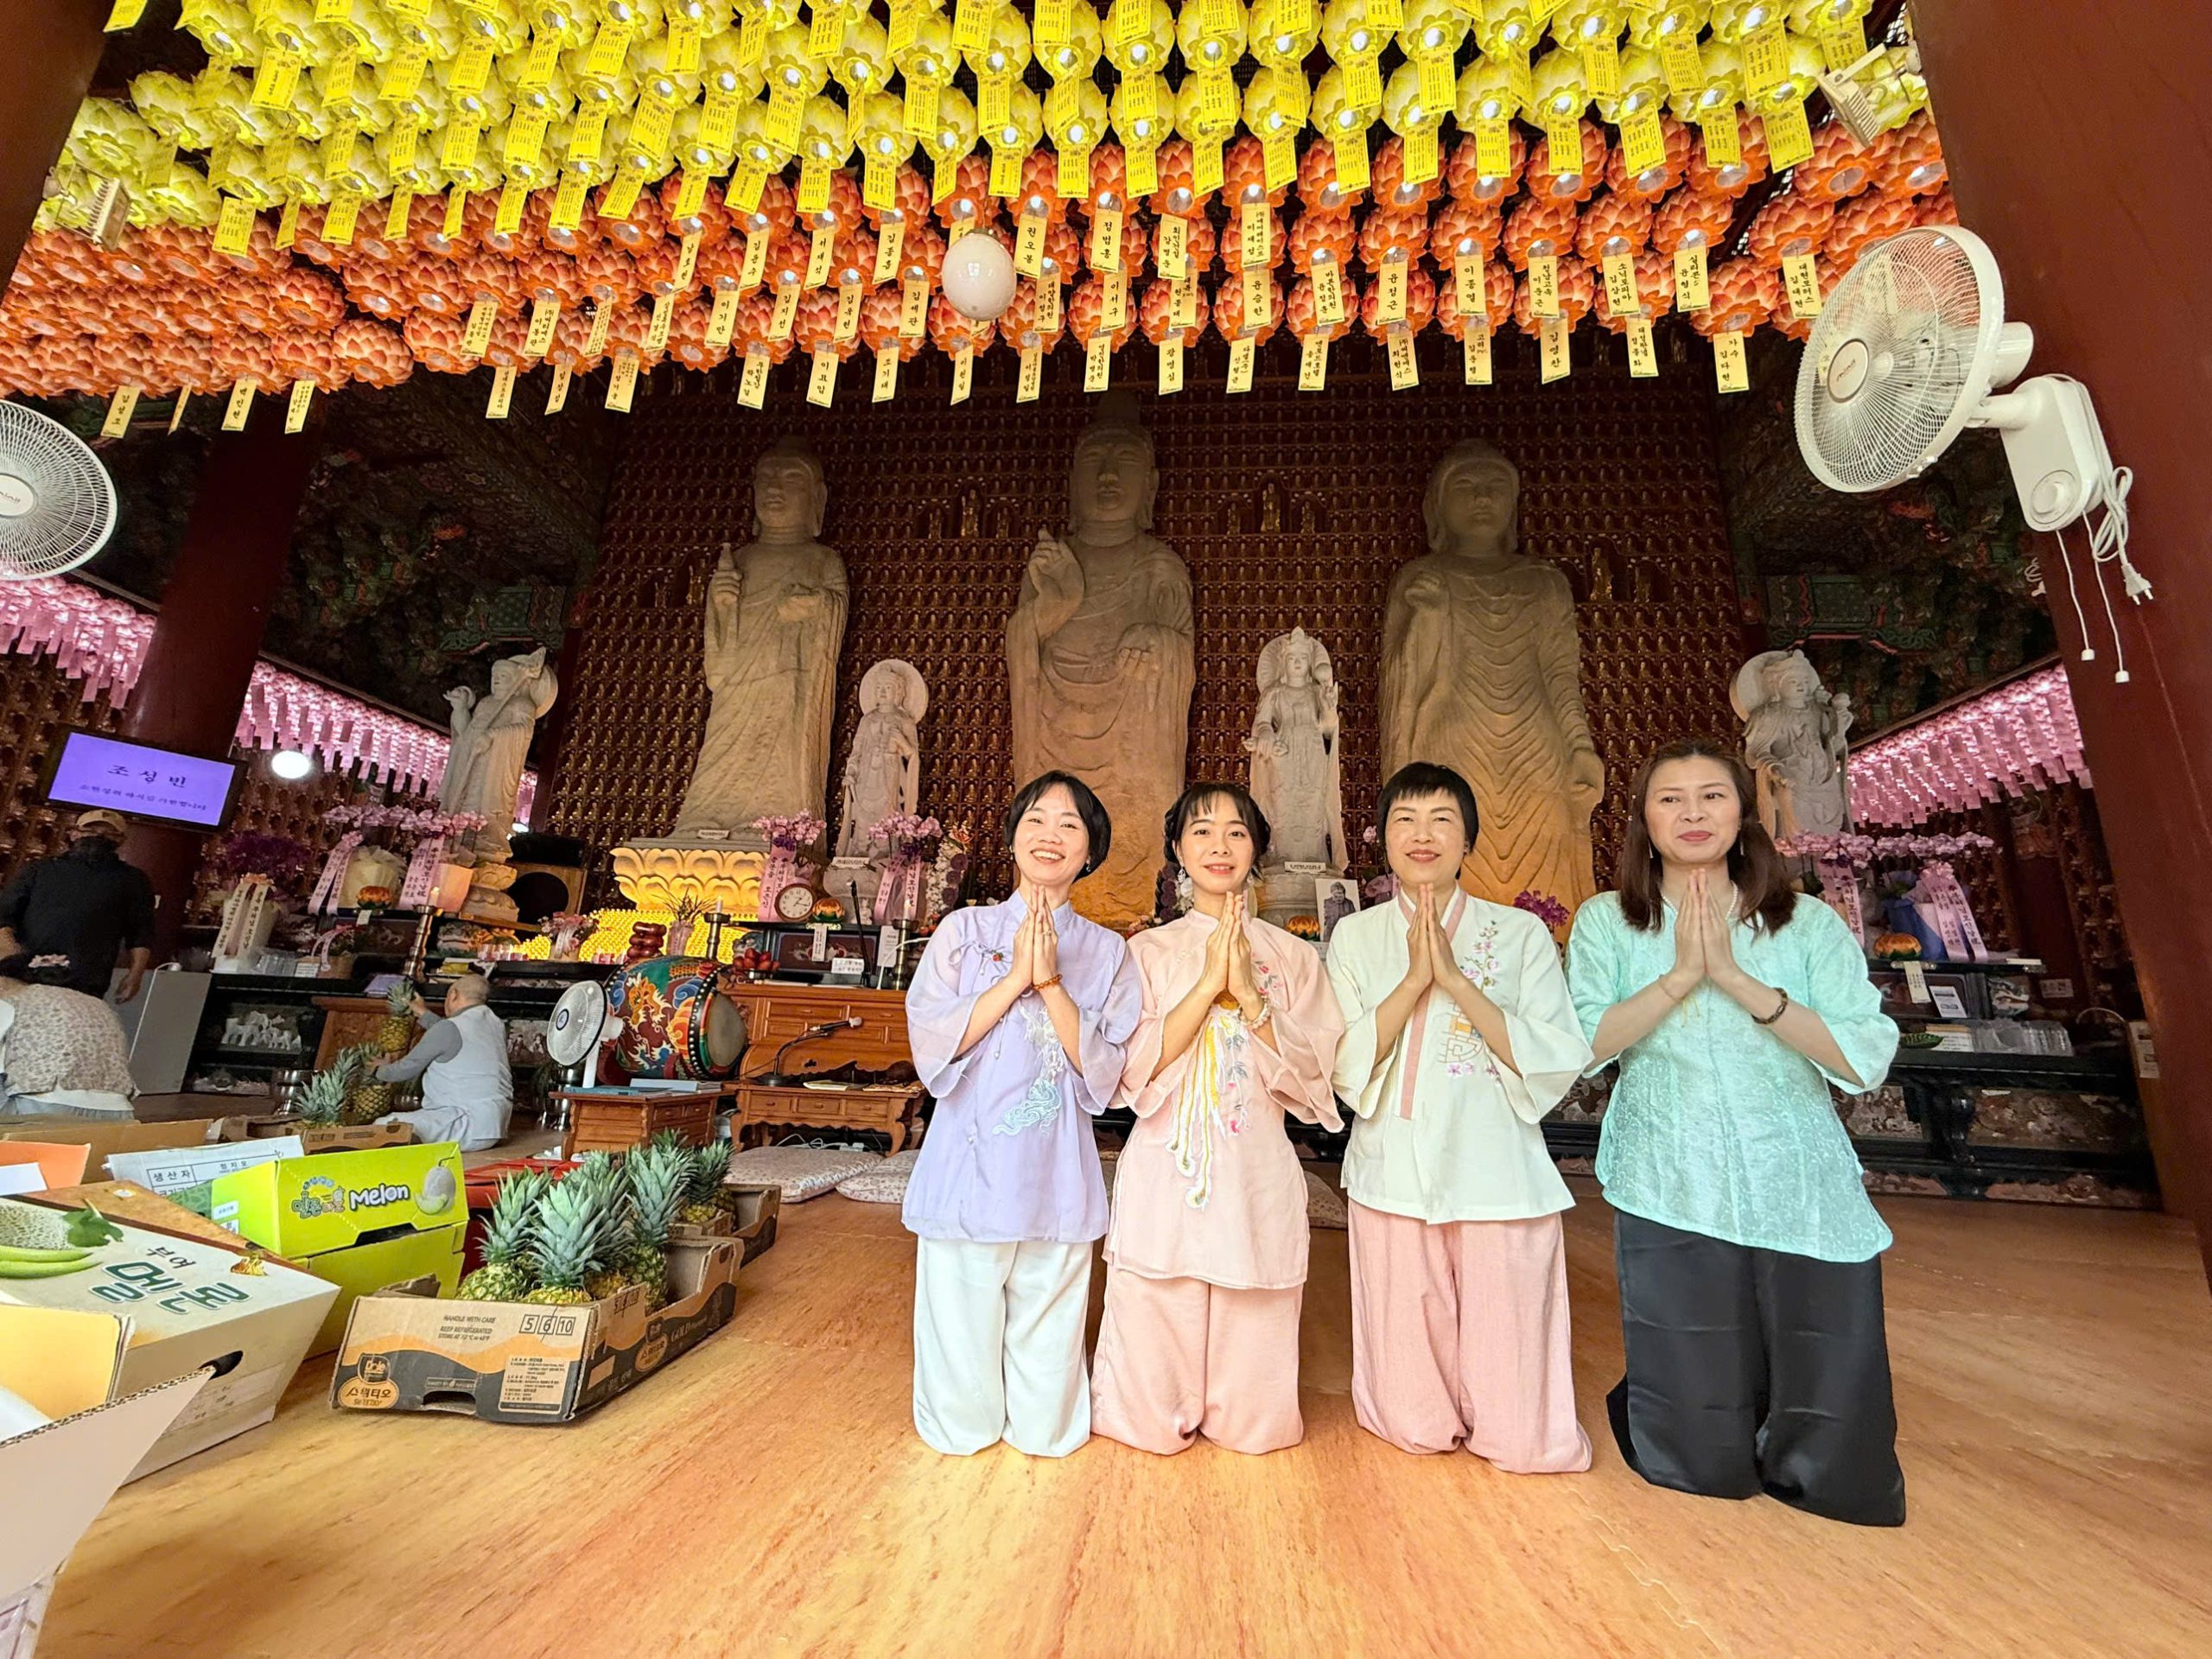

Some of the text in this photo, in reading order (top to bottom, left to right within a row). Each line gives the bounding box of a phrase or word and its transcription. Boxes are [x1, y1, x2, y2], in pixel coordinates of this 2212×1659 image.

[153, 1169, 191, 1183] 생산자
[349, 1183, 410, 1211] Melon
[147, 1247, 196, 1268] 부여
[524, 1318, 573, 1333] 5 6 10
